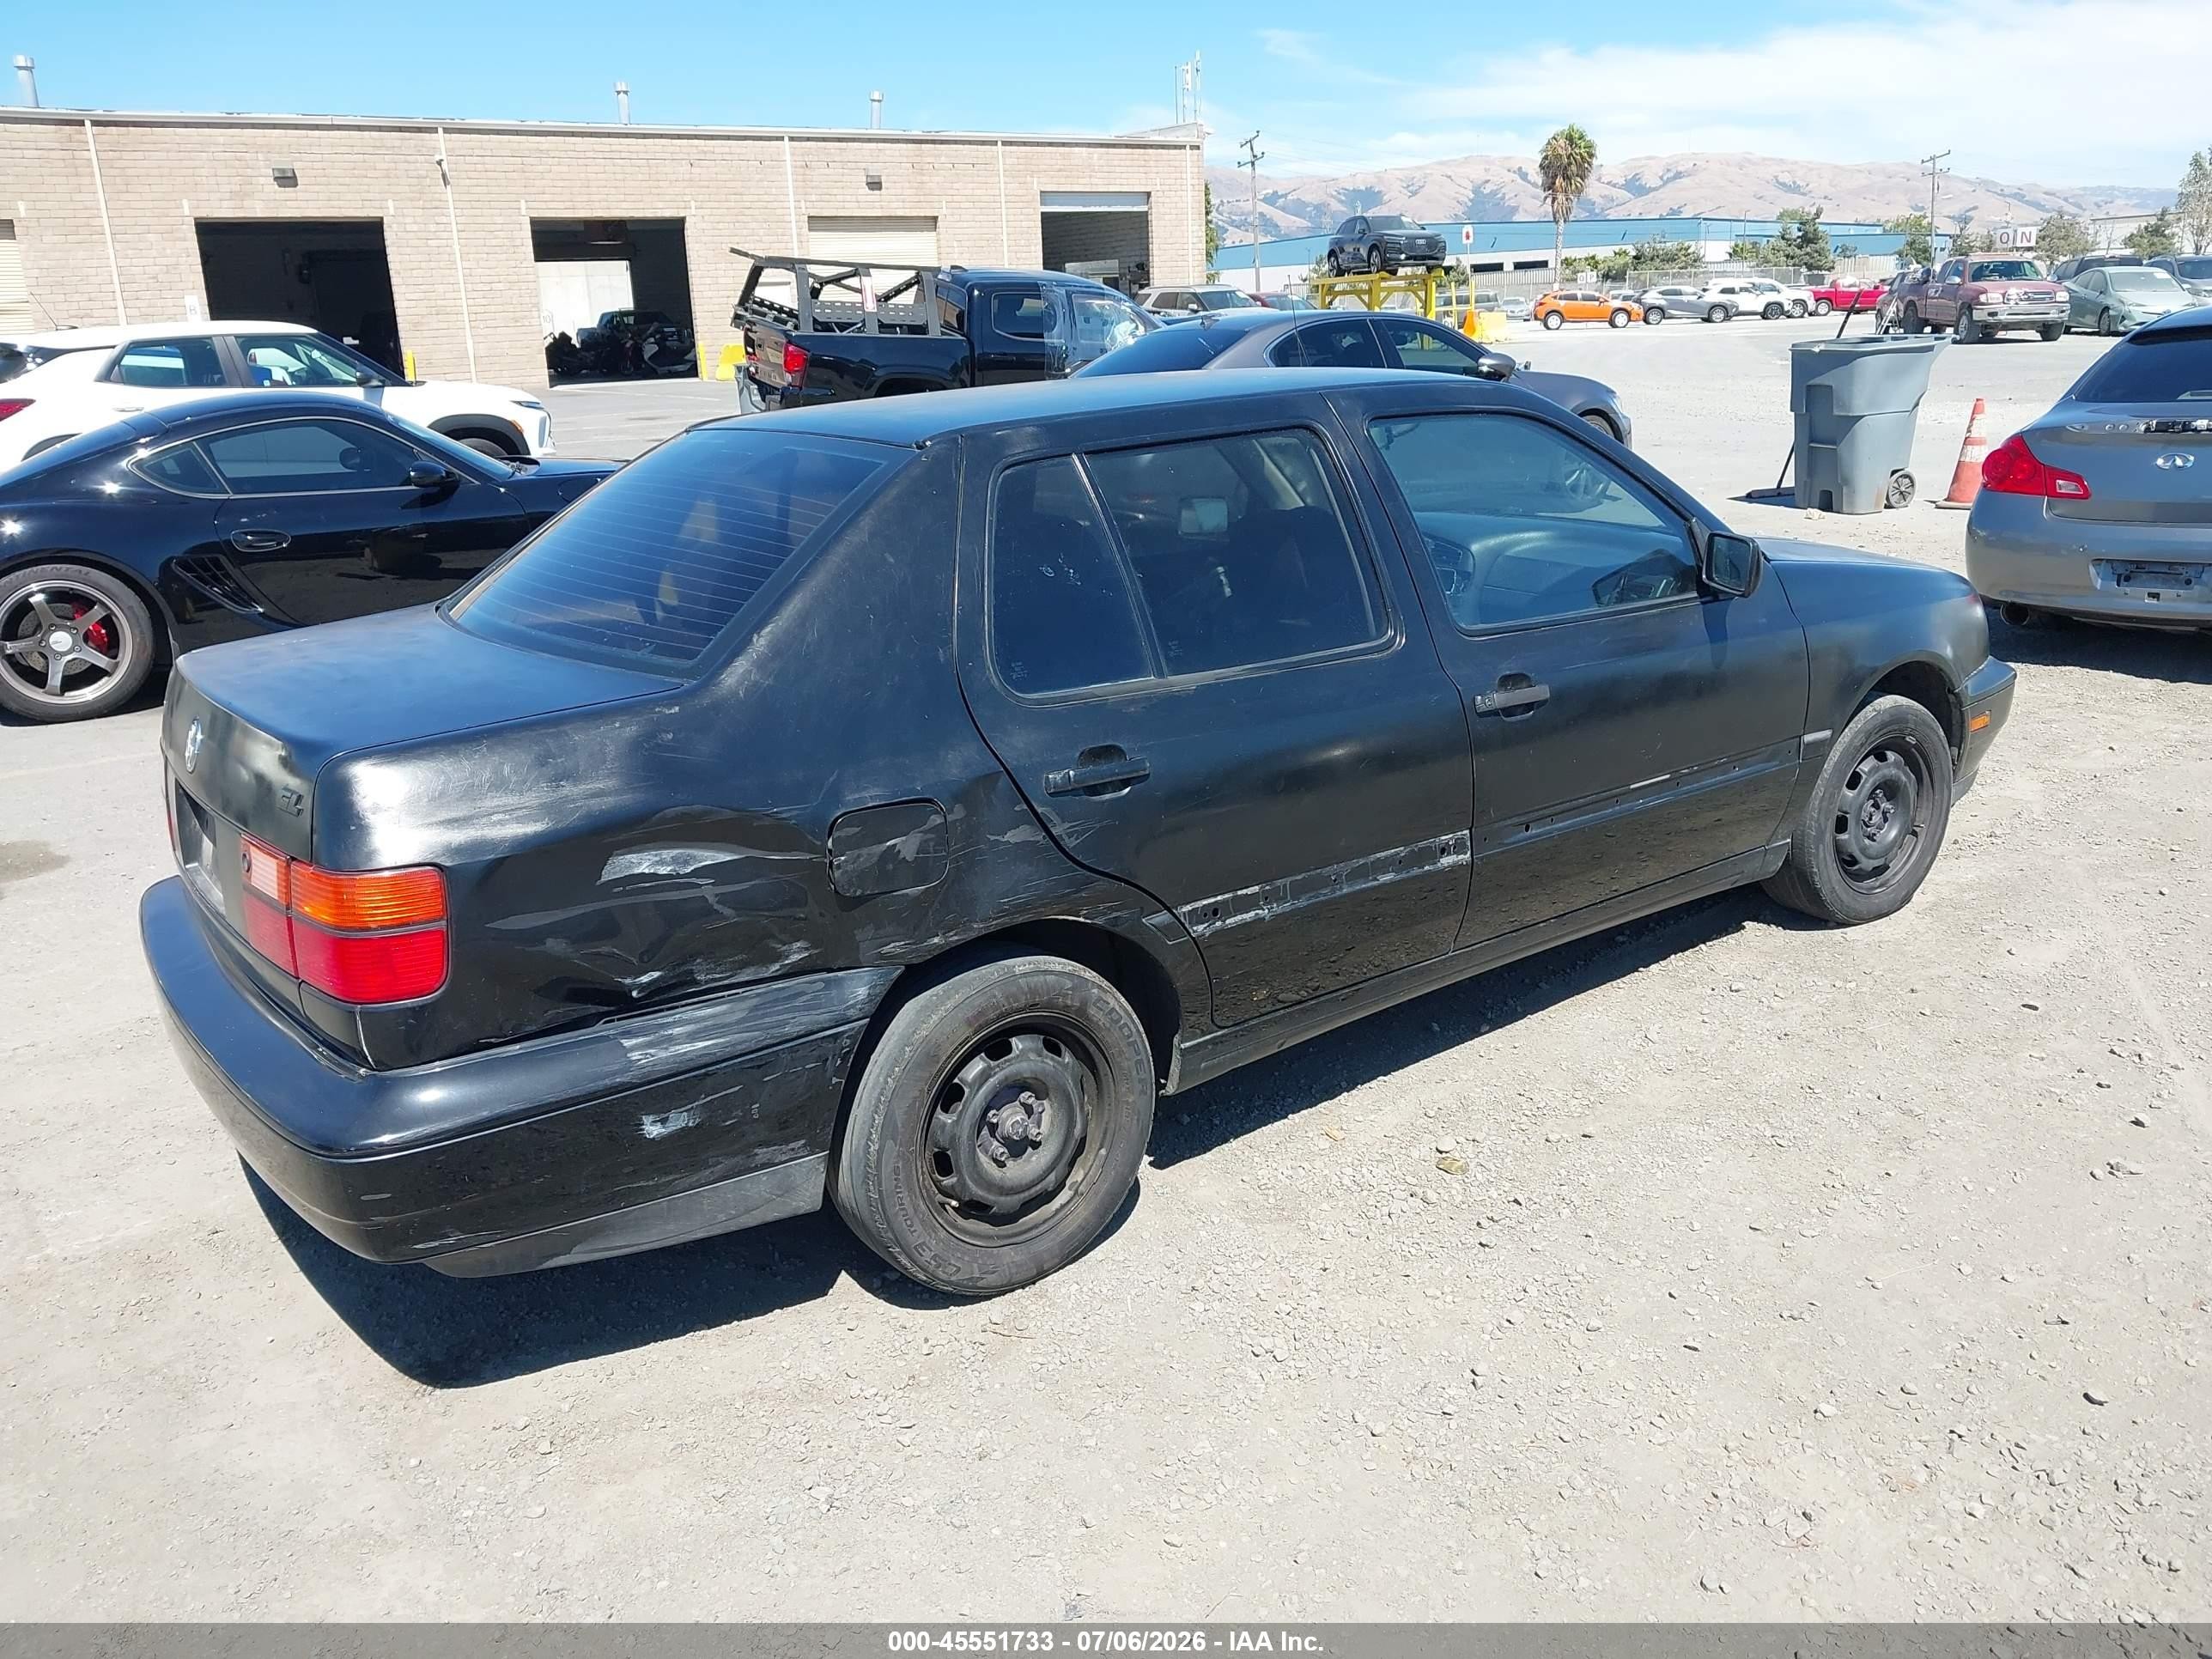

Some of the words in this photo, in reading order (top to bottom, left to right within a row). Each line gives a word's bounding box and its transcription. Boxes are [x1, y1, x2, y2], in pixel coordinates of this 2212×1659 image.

[1999, 231, 2010, 245] O
[2020, 230, 2033, 244] N
[1091, 995, 1150, 1098] COOPER
[893, 1164, 918, 1238] TOURING
